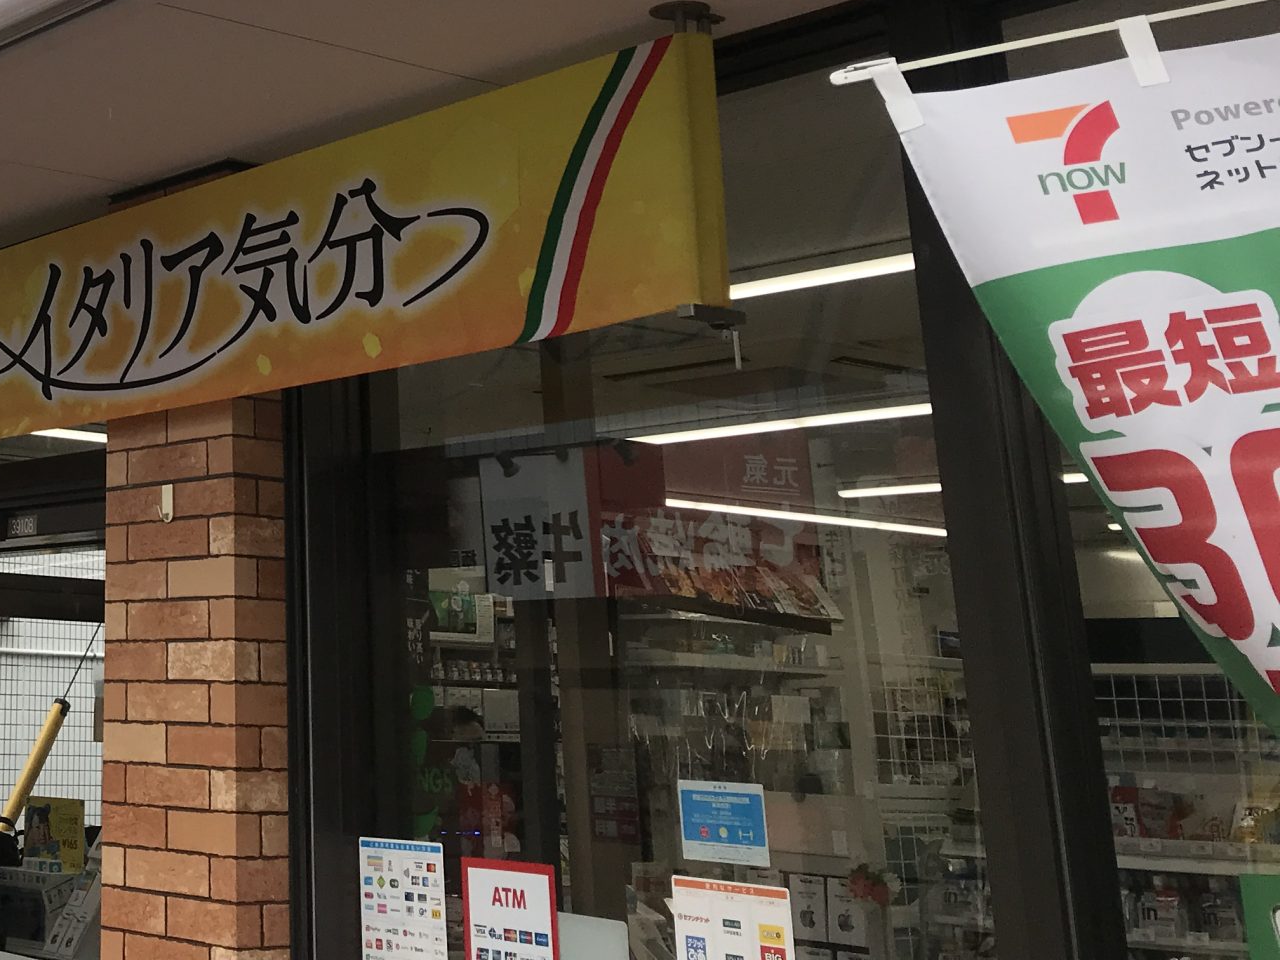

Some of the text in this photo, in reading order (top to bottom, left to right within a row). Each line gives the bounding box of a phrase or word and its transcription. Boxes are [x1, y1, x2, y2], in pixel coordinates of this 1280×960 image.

[1170, 98, 1280, 132] Power
[1037, 161, 1126, 196] now
[1196, 160, 1278, 191] ネット
[1062, 303, 1280, 420] 最短
[492, 887, 528, 910] ATM
